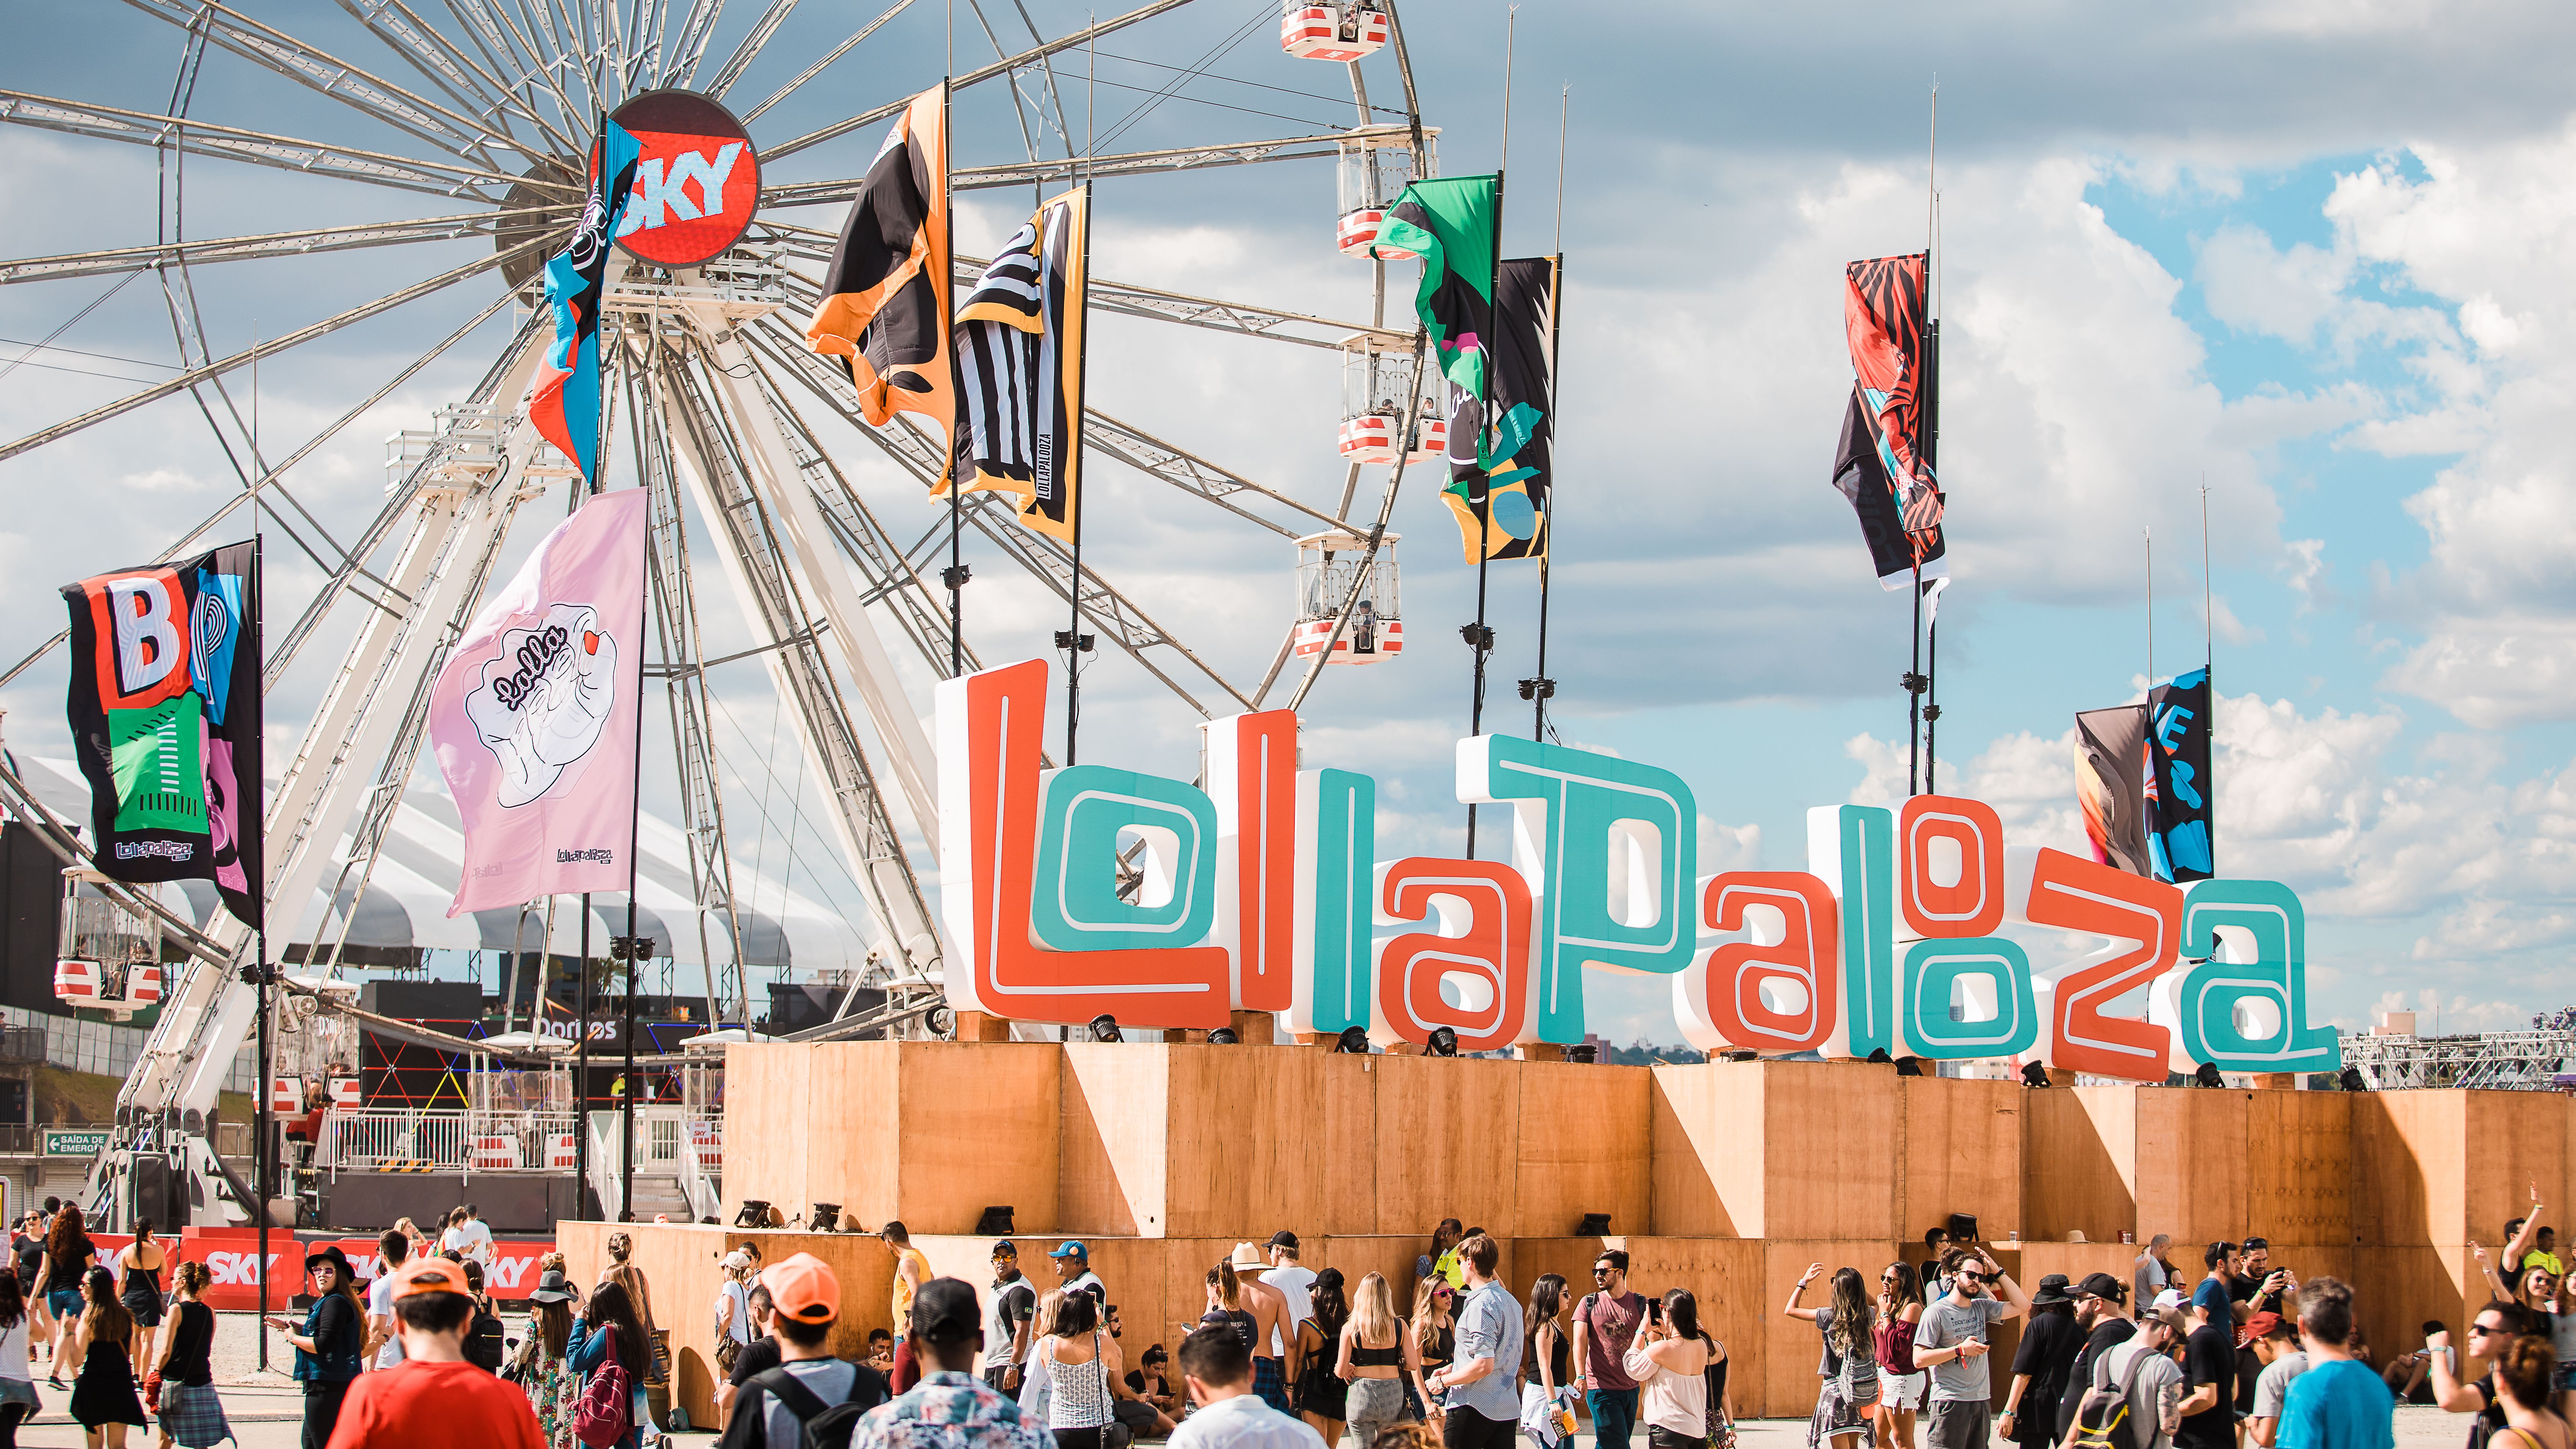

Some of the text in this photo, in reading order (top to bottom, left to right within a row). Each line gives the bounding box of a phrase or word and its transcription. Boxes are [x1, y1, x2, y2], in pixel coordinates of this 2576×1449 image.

[1038, 434, 1051, 497] LOLLAPALOOZA
[61, 1134, 89, 1144] SAÍDA
[206, 1251, 279, 1285] SKY
[484, 1257, 535, 1288] KY
